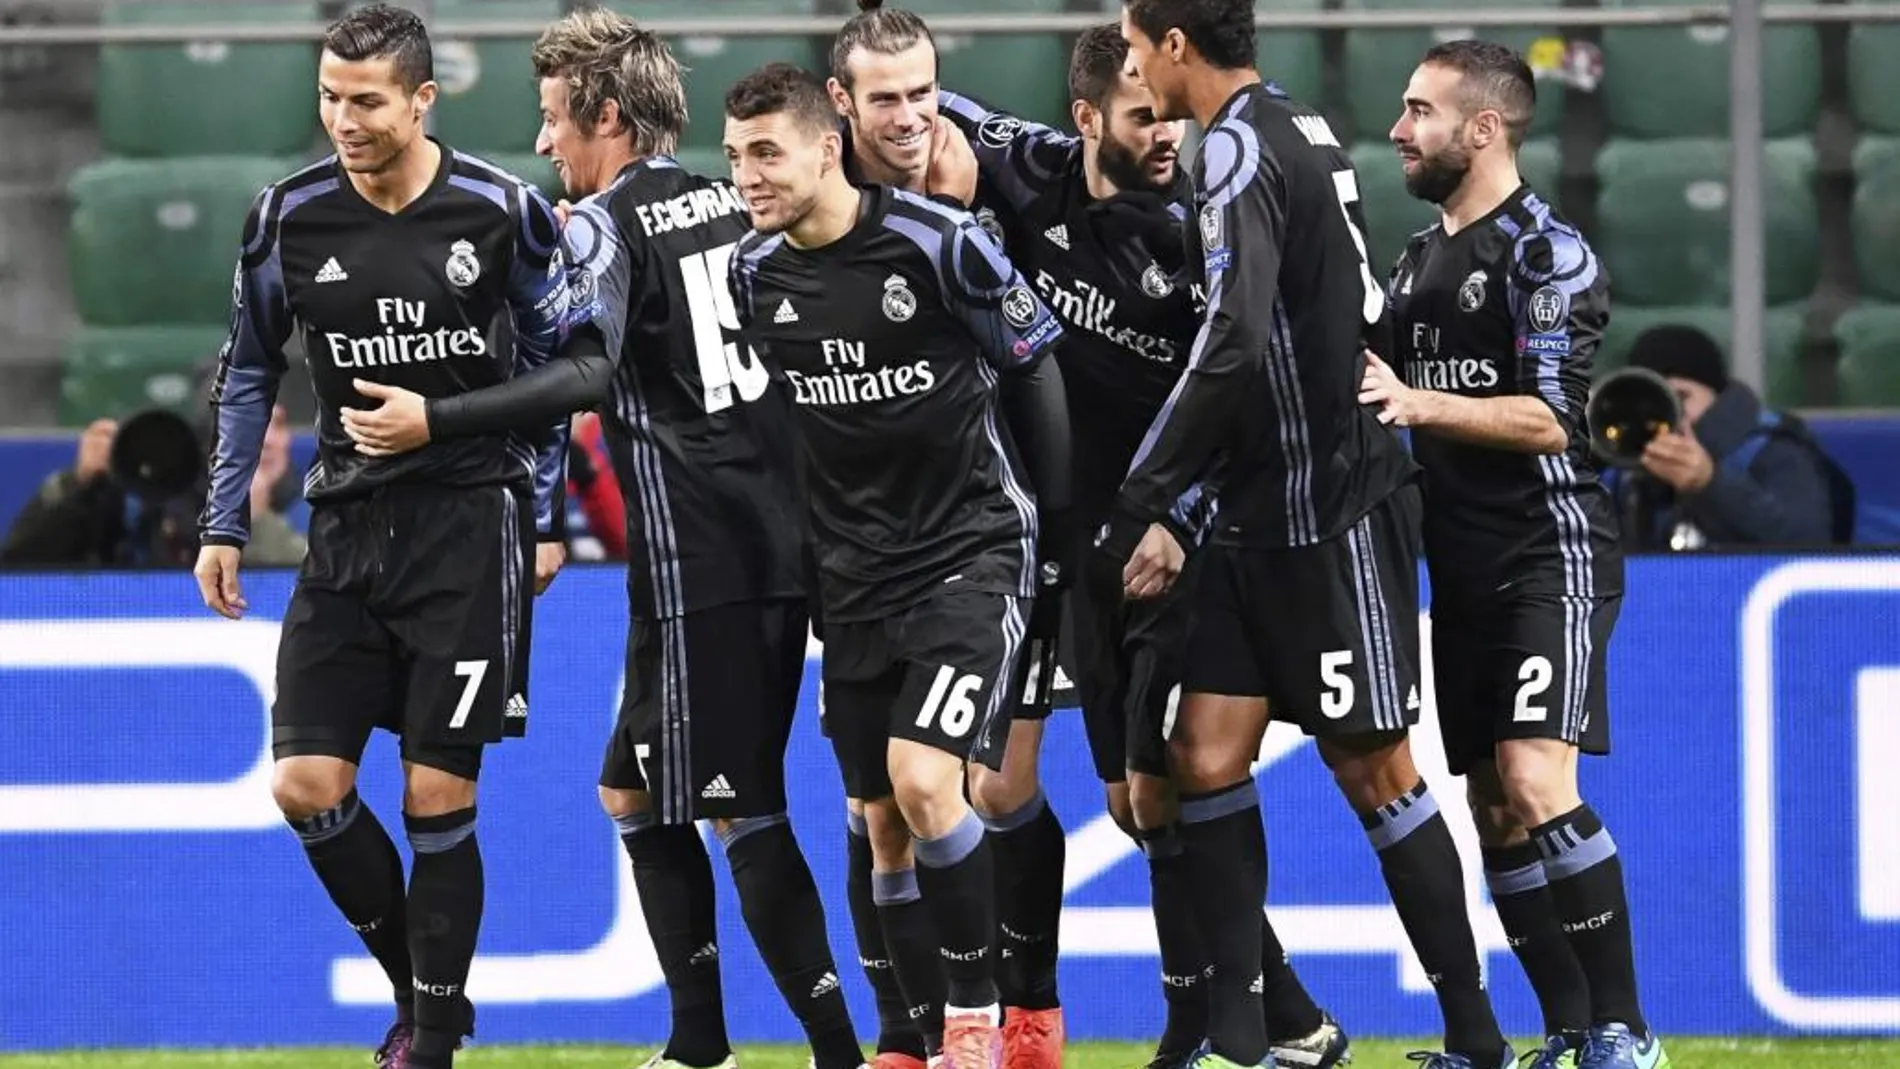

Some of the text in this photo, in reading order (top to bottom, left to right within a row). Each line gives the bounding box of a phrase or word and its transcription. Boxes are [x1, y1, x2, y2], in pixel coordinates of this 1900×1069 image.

[1332, 168, 1385, 325] 5
[377, 297, 425, 328] Fly
[679, 241, 769, 414] 15
[325, 325, 486, 367] Emirates
[821, 338, 865, 368] Fly
[1527, 336, 1569, 350] RESPECT
[784, 360, 935, 405] Emirates
[448, 659, 489, 729] 7
[915, 664, 983, 738] 16
[1320, 650, 1355, 720] 5
[1513, 655, 1553, 722] 2
[701, 789, 736, 799] adidas
[1161, 971, 1197, 988] MCF
